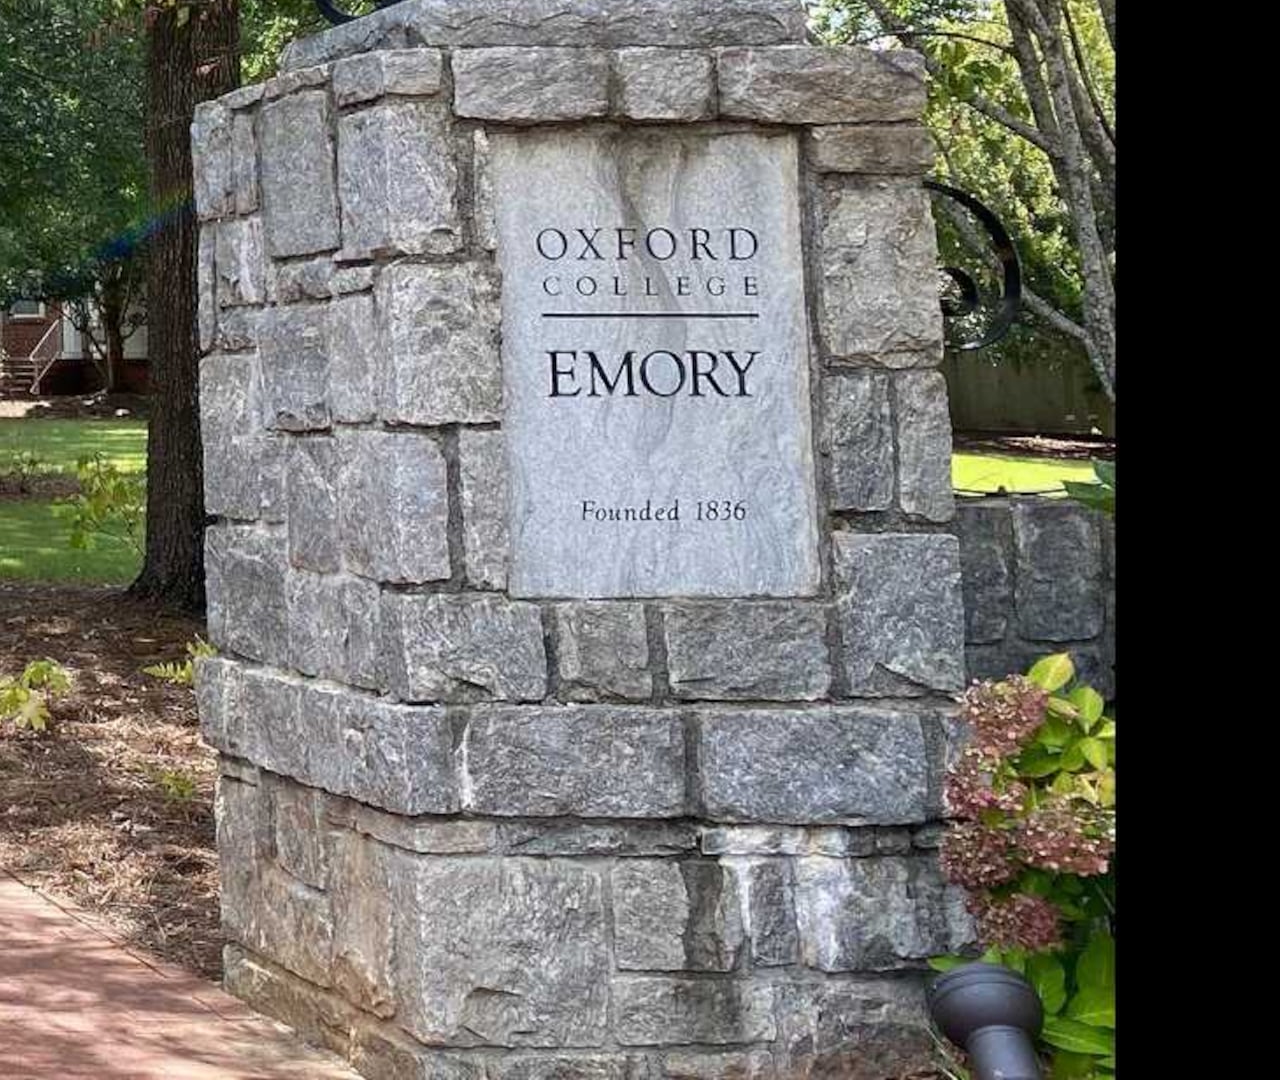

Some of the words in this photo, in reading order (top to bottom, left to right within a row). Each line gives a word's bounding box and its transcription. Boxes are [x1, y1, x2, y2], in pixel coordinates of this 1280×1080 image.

[536, 227, 759, 261] OXFORD
[542, 276, 759, 296] COLLEGE
[546, 350, 761, 398] EMORY
[581, 500, 680, 522] Founded
[696, 500, 747, 522] 1836
